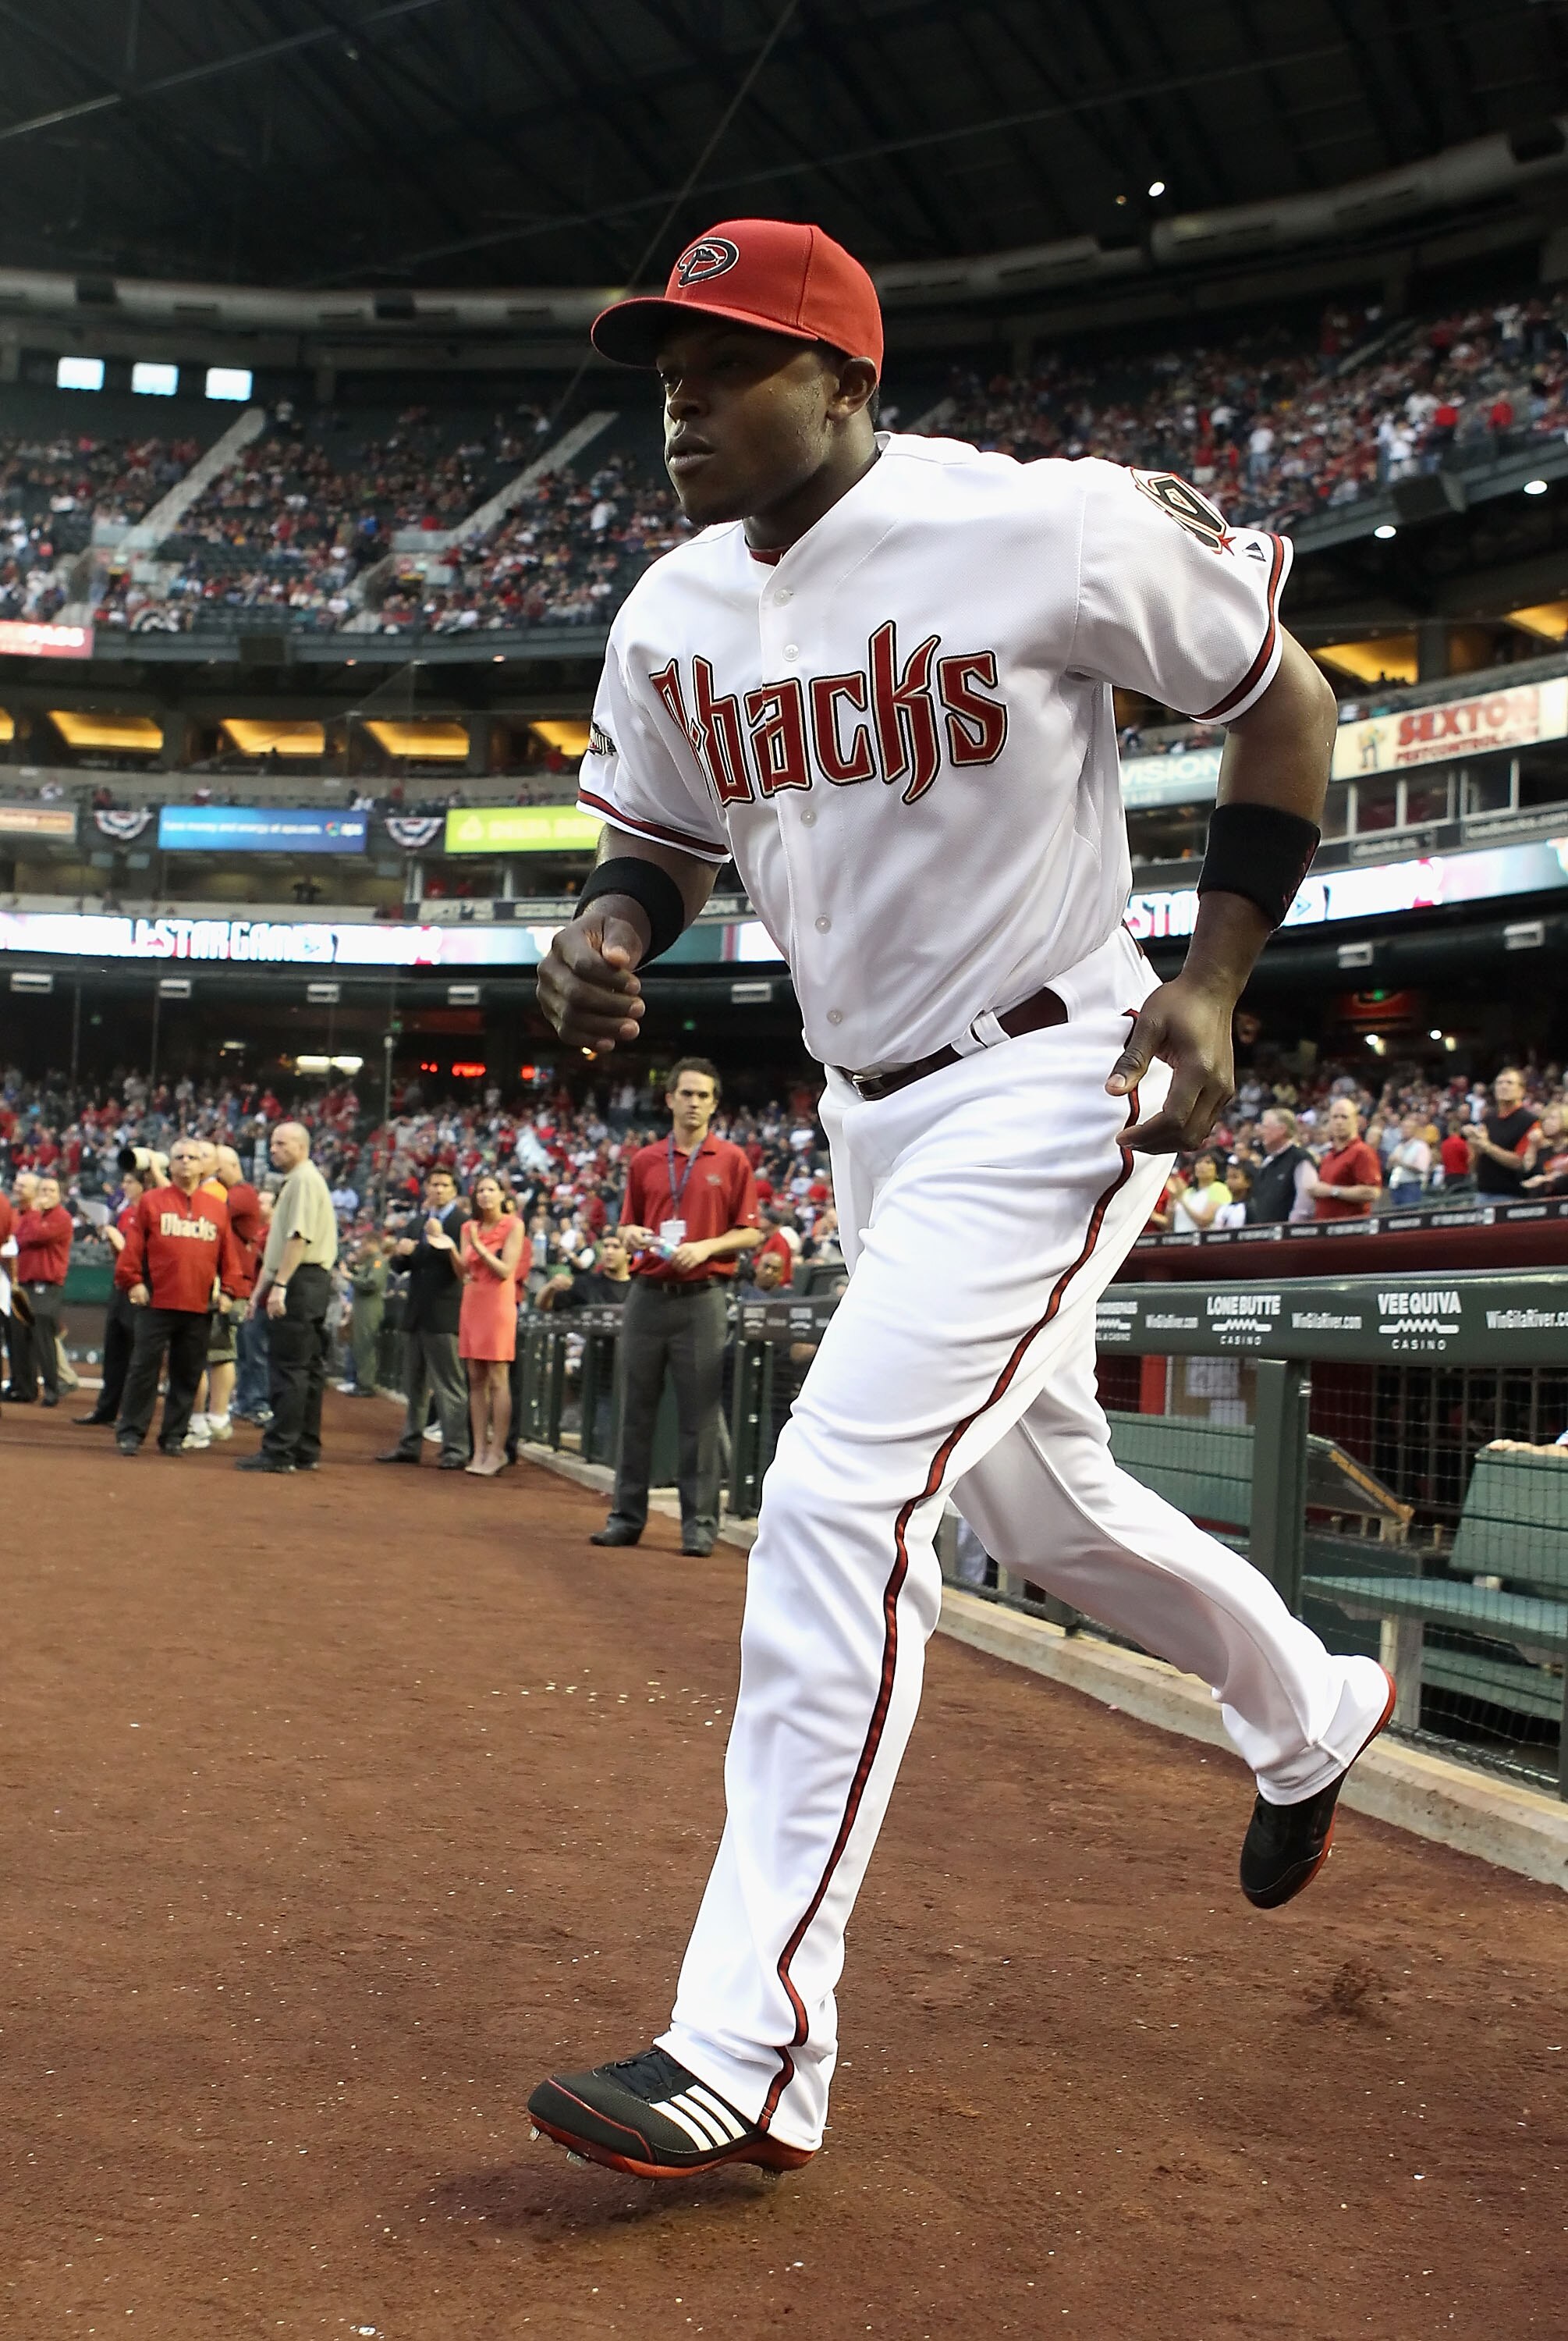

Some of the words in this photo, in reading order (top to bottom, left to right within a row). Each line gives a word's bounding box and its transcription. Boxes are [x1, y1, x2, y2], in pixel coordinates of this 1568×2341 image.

[1398, 687, 1539, 746] SEXTON
[1378, 1293, 1409, 1315] VEE
[1409, 1291, 1462, 1314] QUIVA
[1220, 1335, 1262, 1345] CASINO
[1392, 1339, 1446, 1351] CASINO
